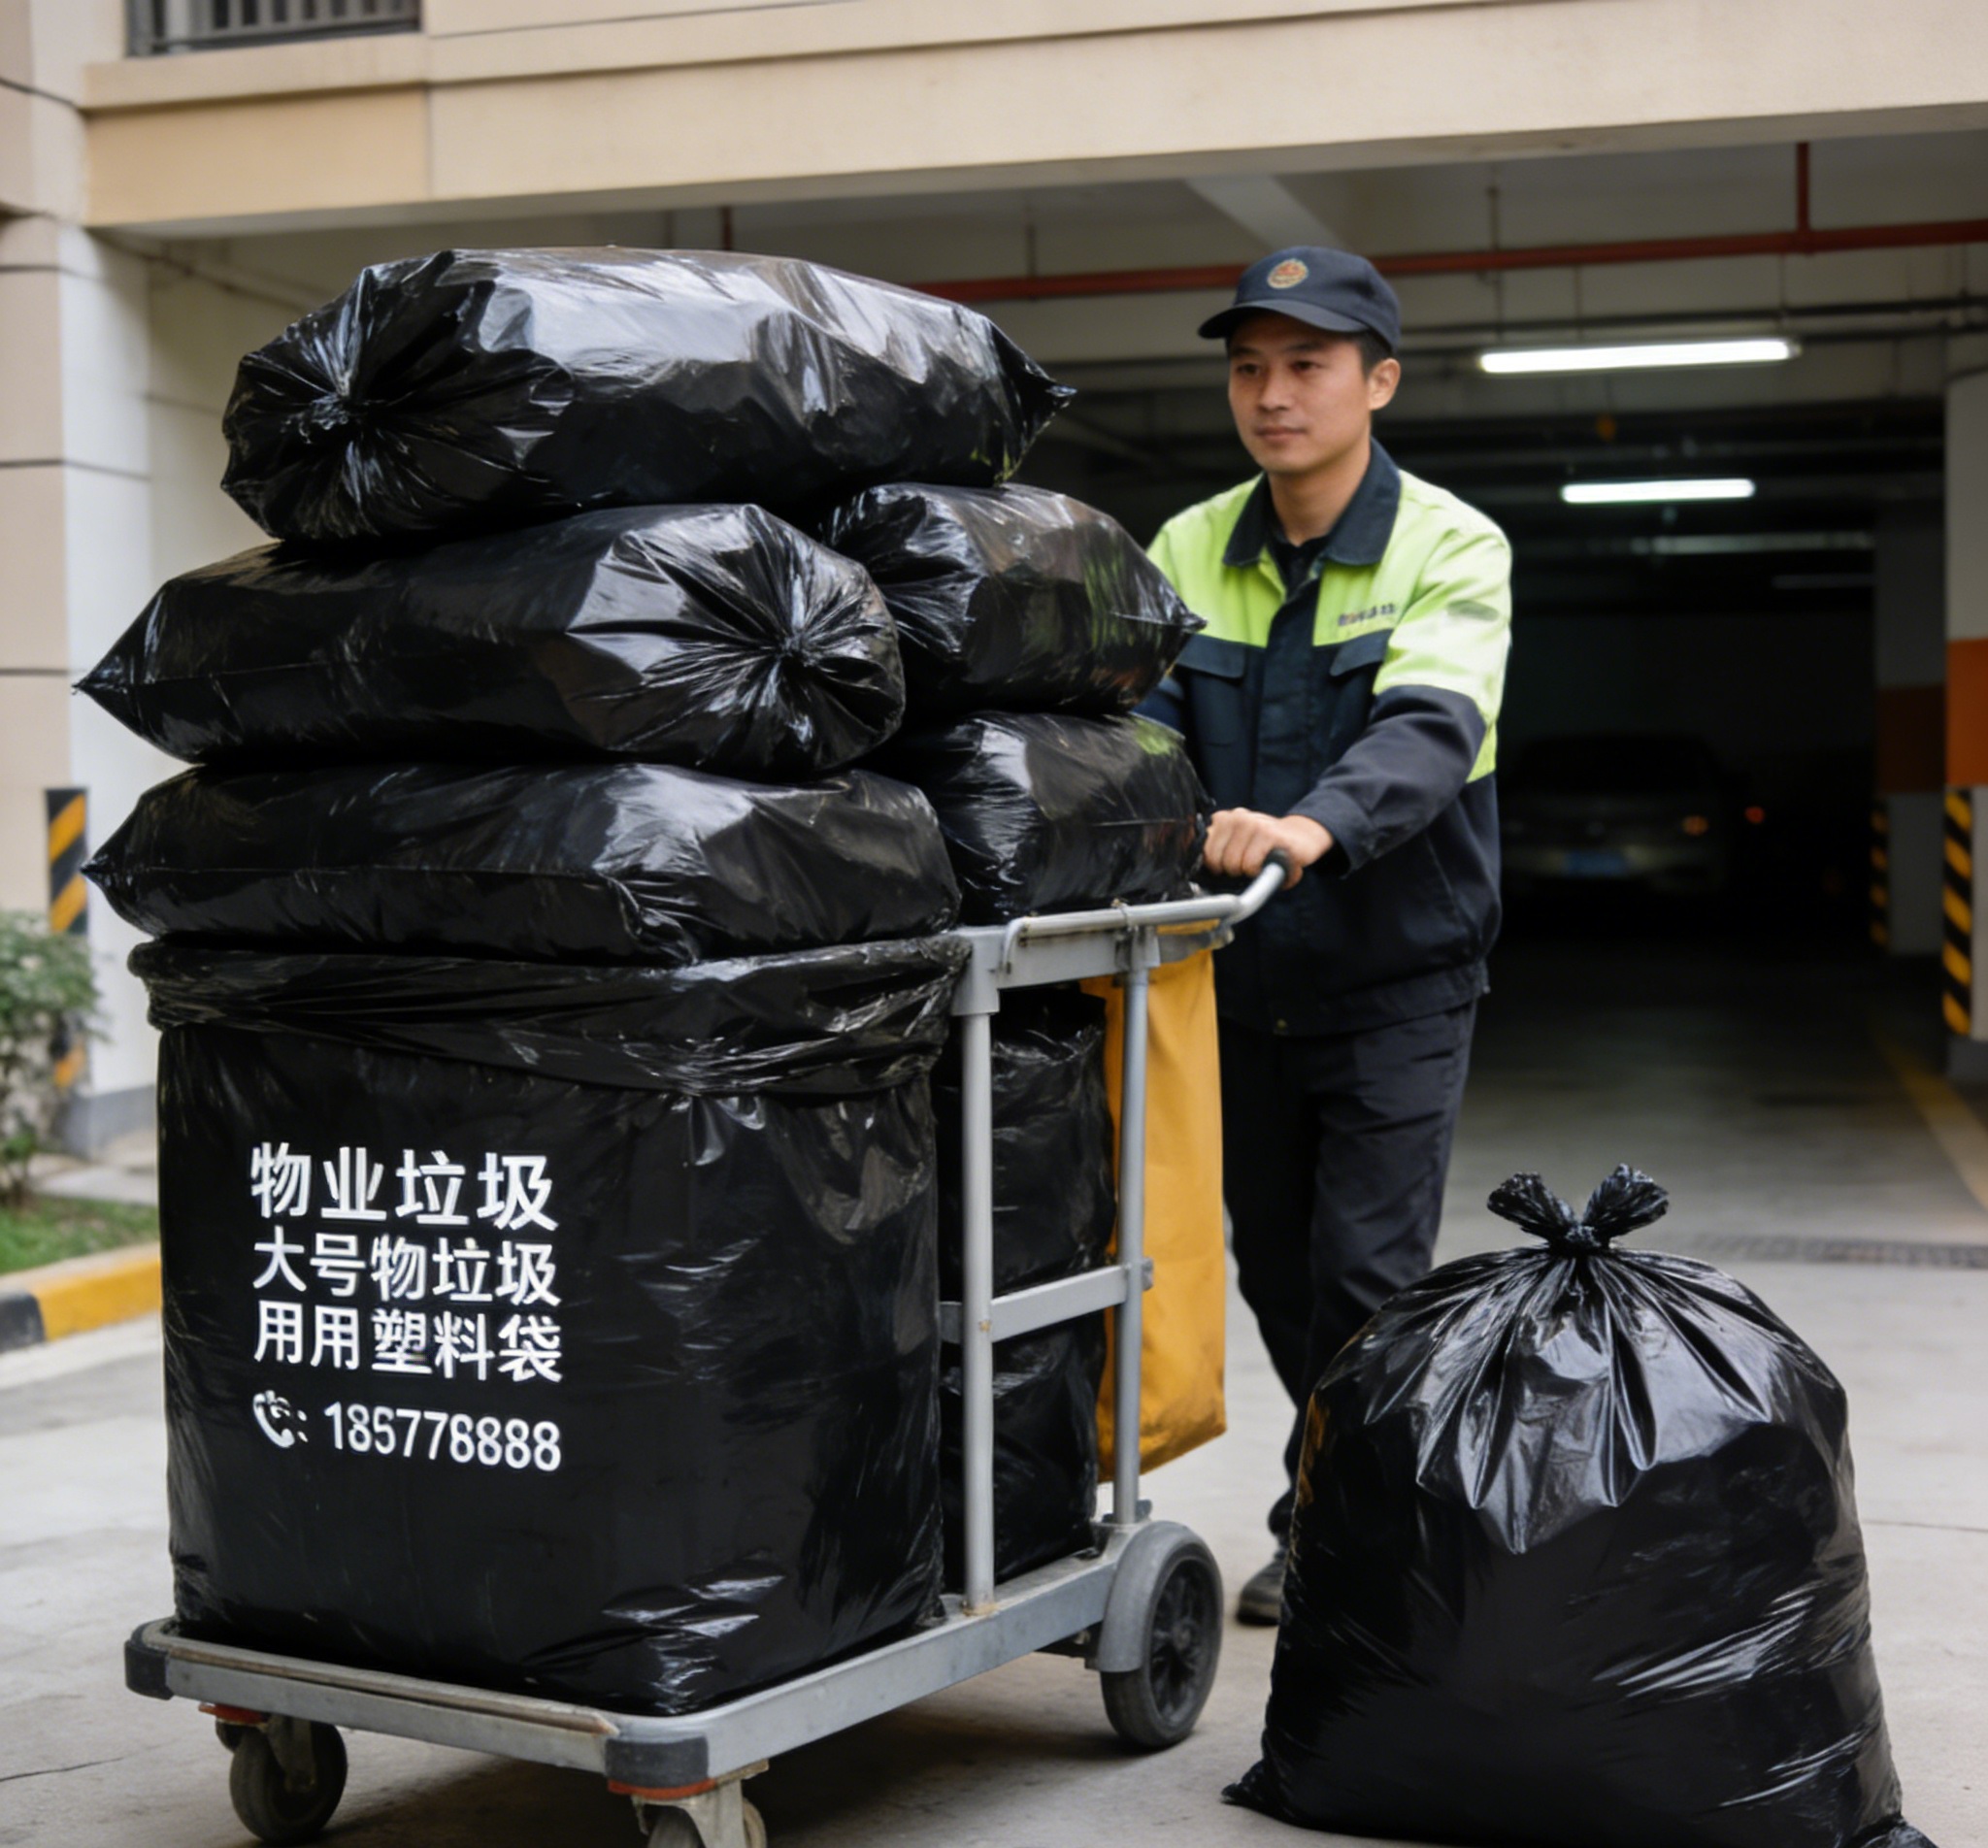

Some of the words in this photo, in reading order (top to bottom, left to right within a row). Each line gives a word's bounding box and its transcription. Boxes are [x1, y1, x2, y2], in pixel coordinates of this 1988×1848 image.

[251, 1142, 559, 1231] 物业垃圾
[253, 1226, 561, 1306] 大号物垃圾
[253, 1300, 562, 1382] 用用塑料袋
